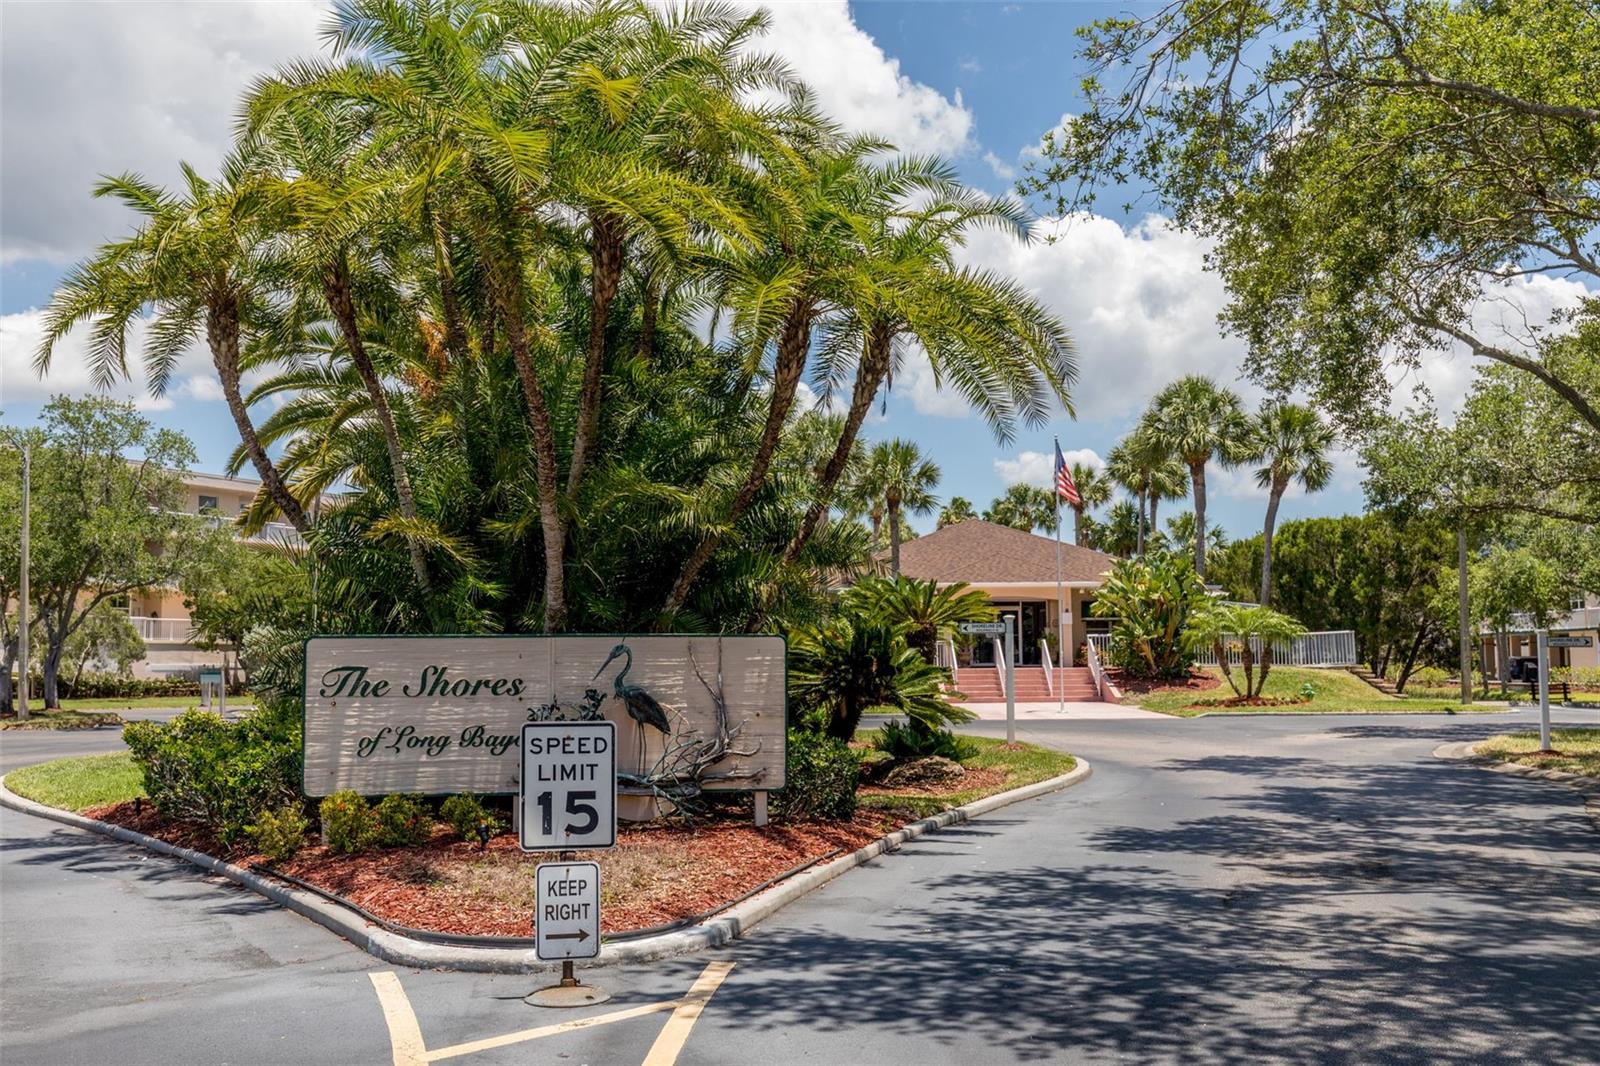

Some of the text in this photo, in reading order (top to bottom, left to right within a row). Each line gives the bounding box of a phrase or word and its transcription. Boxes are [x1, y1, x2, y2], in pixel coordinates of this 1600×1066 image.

[320, 665, 527, 697] The Shores
[357, 726, 392, 758] of
[386, 725, 452, 757] Long
[529, 737, 608, 755] SPEED
[538, 764, 599, 781] LIMIT
[537, 791, 600, 836] 15
[547, 879, 588, 897] KEEP
[545, 903, 591, 921] RIGHT
